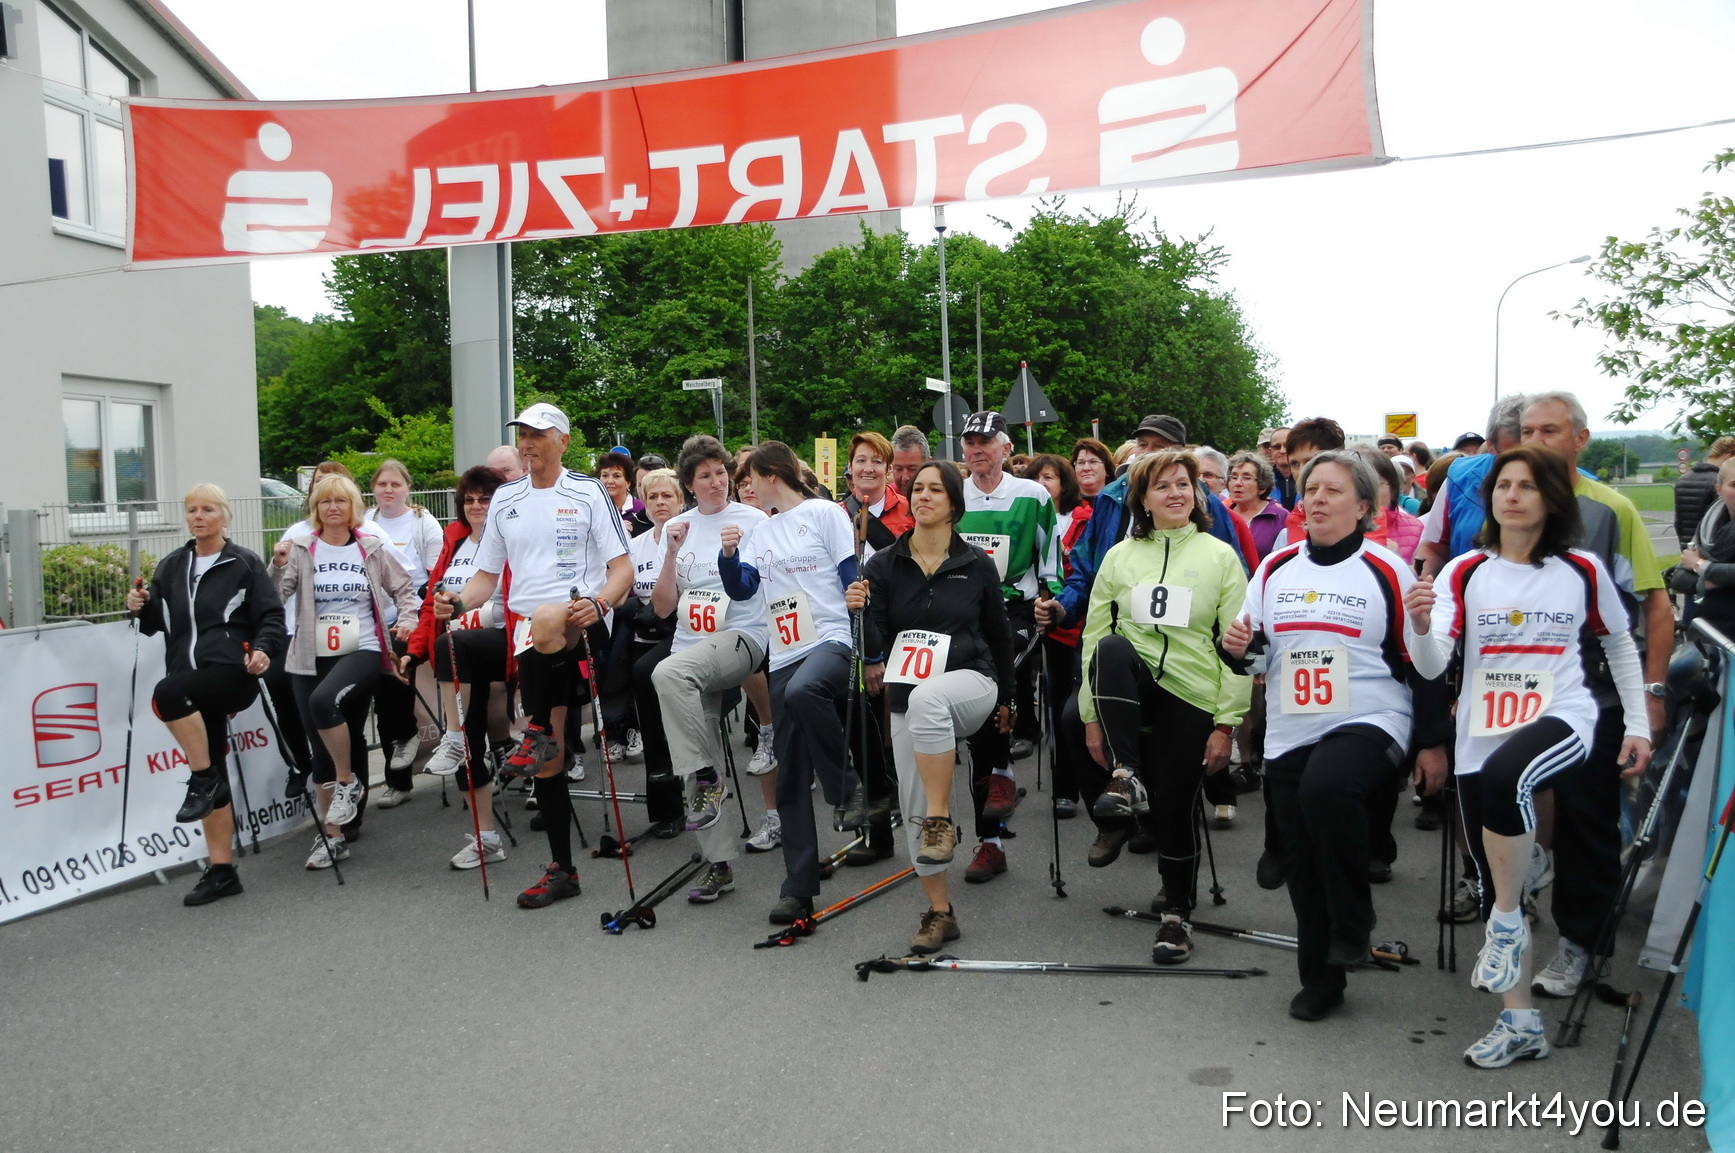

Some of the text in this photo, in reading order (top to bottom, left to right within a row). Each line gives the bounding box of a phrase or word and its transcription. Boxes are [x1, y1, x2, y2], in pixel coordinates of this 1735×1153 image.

[637, 561, 654, 574] BE
[342, 583, 371, 593] GIRLS
[1150, 586, 1168, 619] 8
[689, 604, 716, 633] 56
[770, 600, 786, 610] MEYER
[327, 625, 340, 651] 6
[775, 611, 801, 645] 57
[900, 646, 933, 679] 70
[1290, 651, 1318, 659] MEYER
[1294, 668, 1332, 706] 95
[1485, 673, 1522, 681] MEYER
[1483, 691, 1542, 728] 100
[146, 748, 189, 774] KIA
[13, 764, 127, 808] SEAT
[22, 841, 137, 896] 09181/26
[137, 826, 190, 857] 80-0
